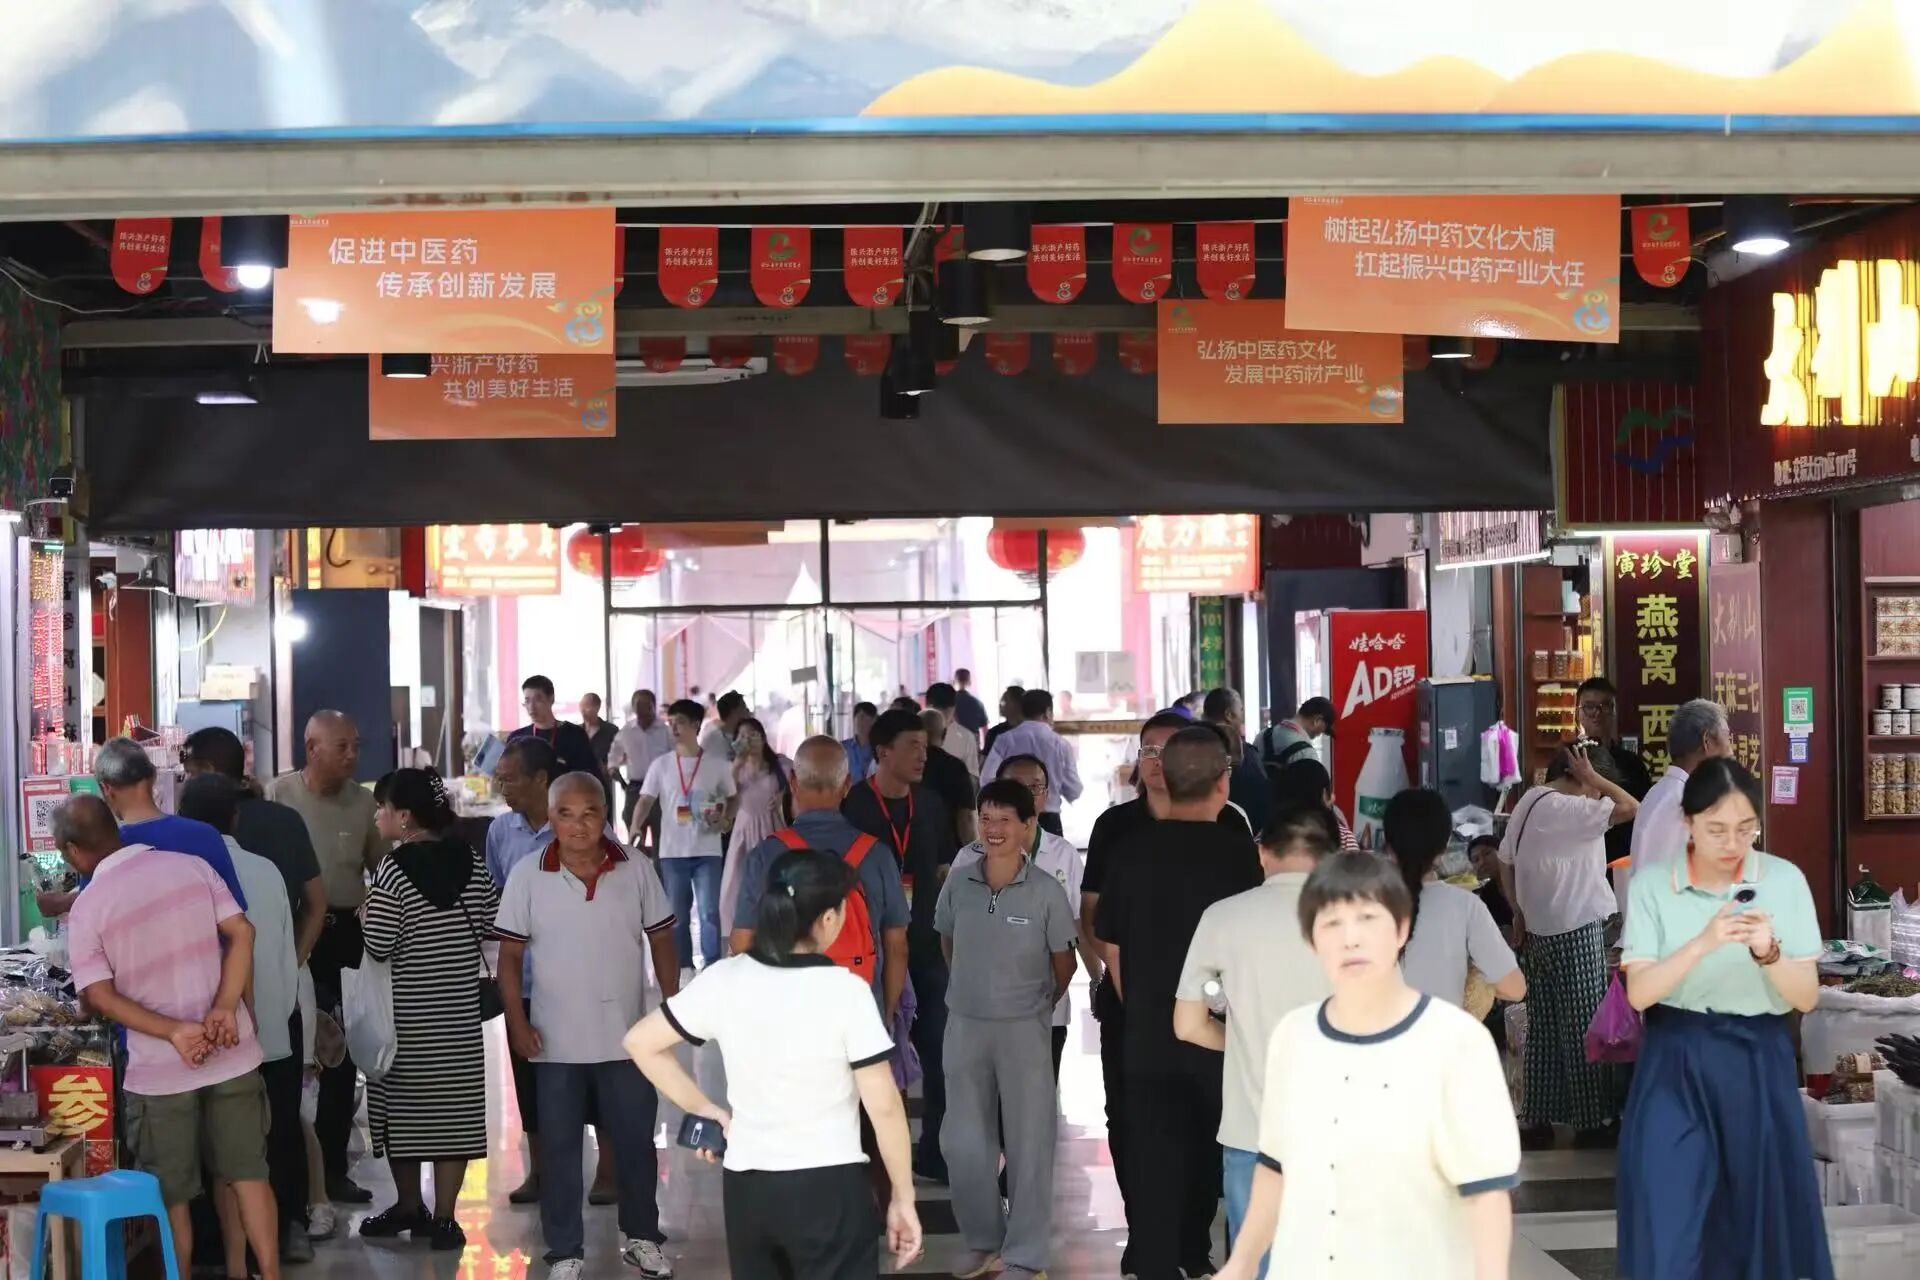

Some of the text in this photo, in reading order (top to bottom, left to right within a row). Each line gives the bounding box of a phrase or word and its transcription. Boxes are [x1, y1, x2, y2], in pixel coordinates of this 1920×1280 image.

[1324, 215, 1555, 253] 树起弘扬中药文化大旗
[328, 237, 478, 265] 促进中医药
[1354, 250, 1586, 287] 扛起振兴中药产业大任
[375, 271, 558, 299] 传承创新发展
[431, 354, 539, 375] 兴浙产好药
[1197, 340, 1337, 361] 弘扬中医药文化
[443, 377, 575, 399] 共创美好生活
[1225, 364, 1364, 385] 发展中药材产业
[1615, 548, 1698, 580] 寅珍堂
[1713, 592, 1758, 646] 大别山
[1349, 632, 1406, 652] 娃哈哈
[1635, 593, 1680, 686] 燕窝
[1340, 660, 1416, 720] AD钙
[1714, 668, 1761, 714] 天麻三七
[46, 1074, 109, 1136] 参
